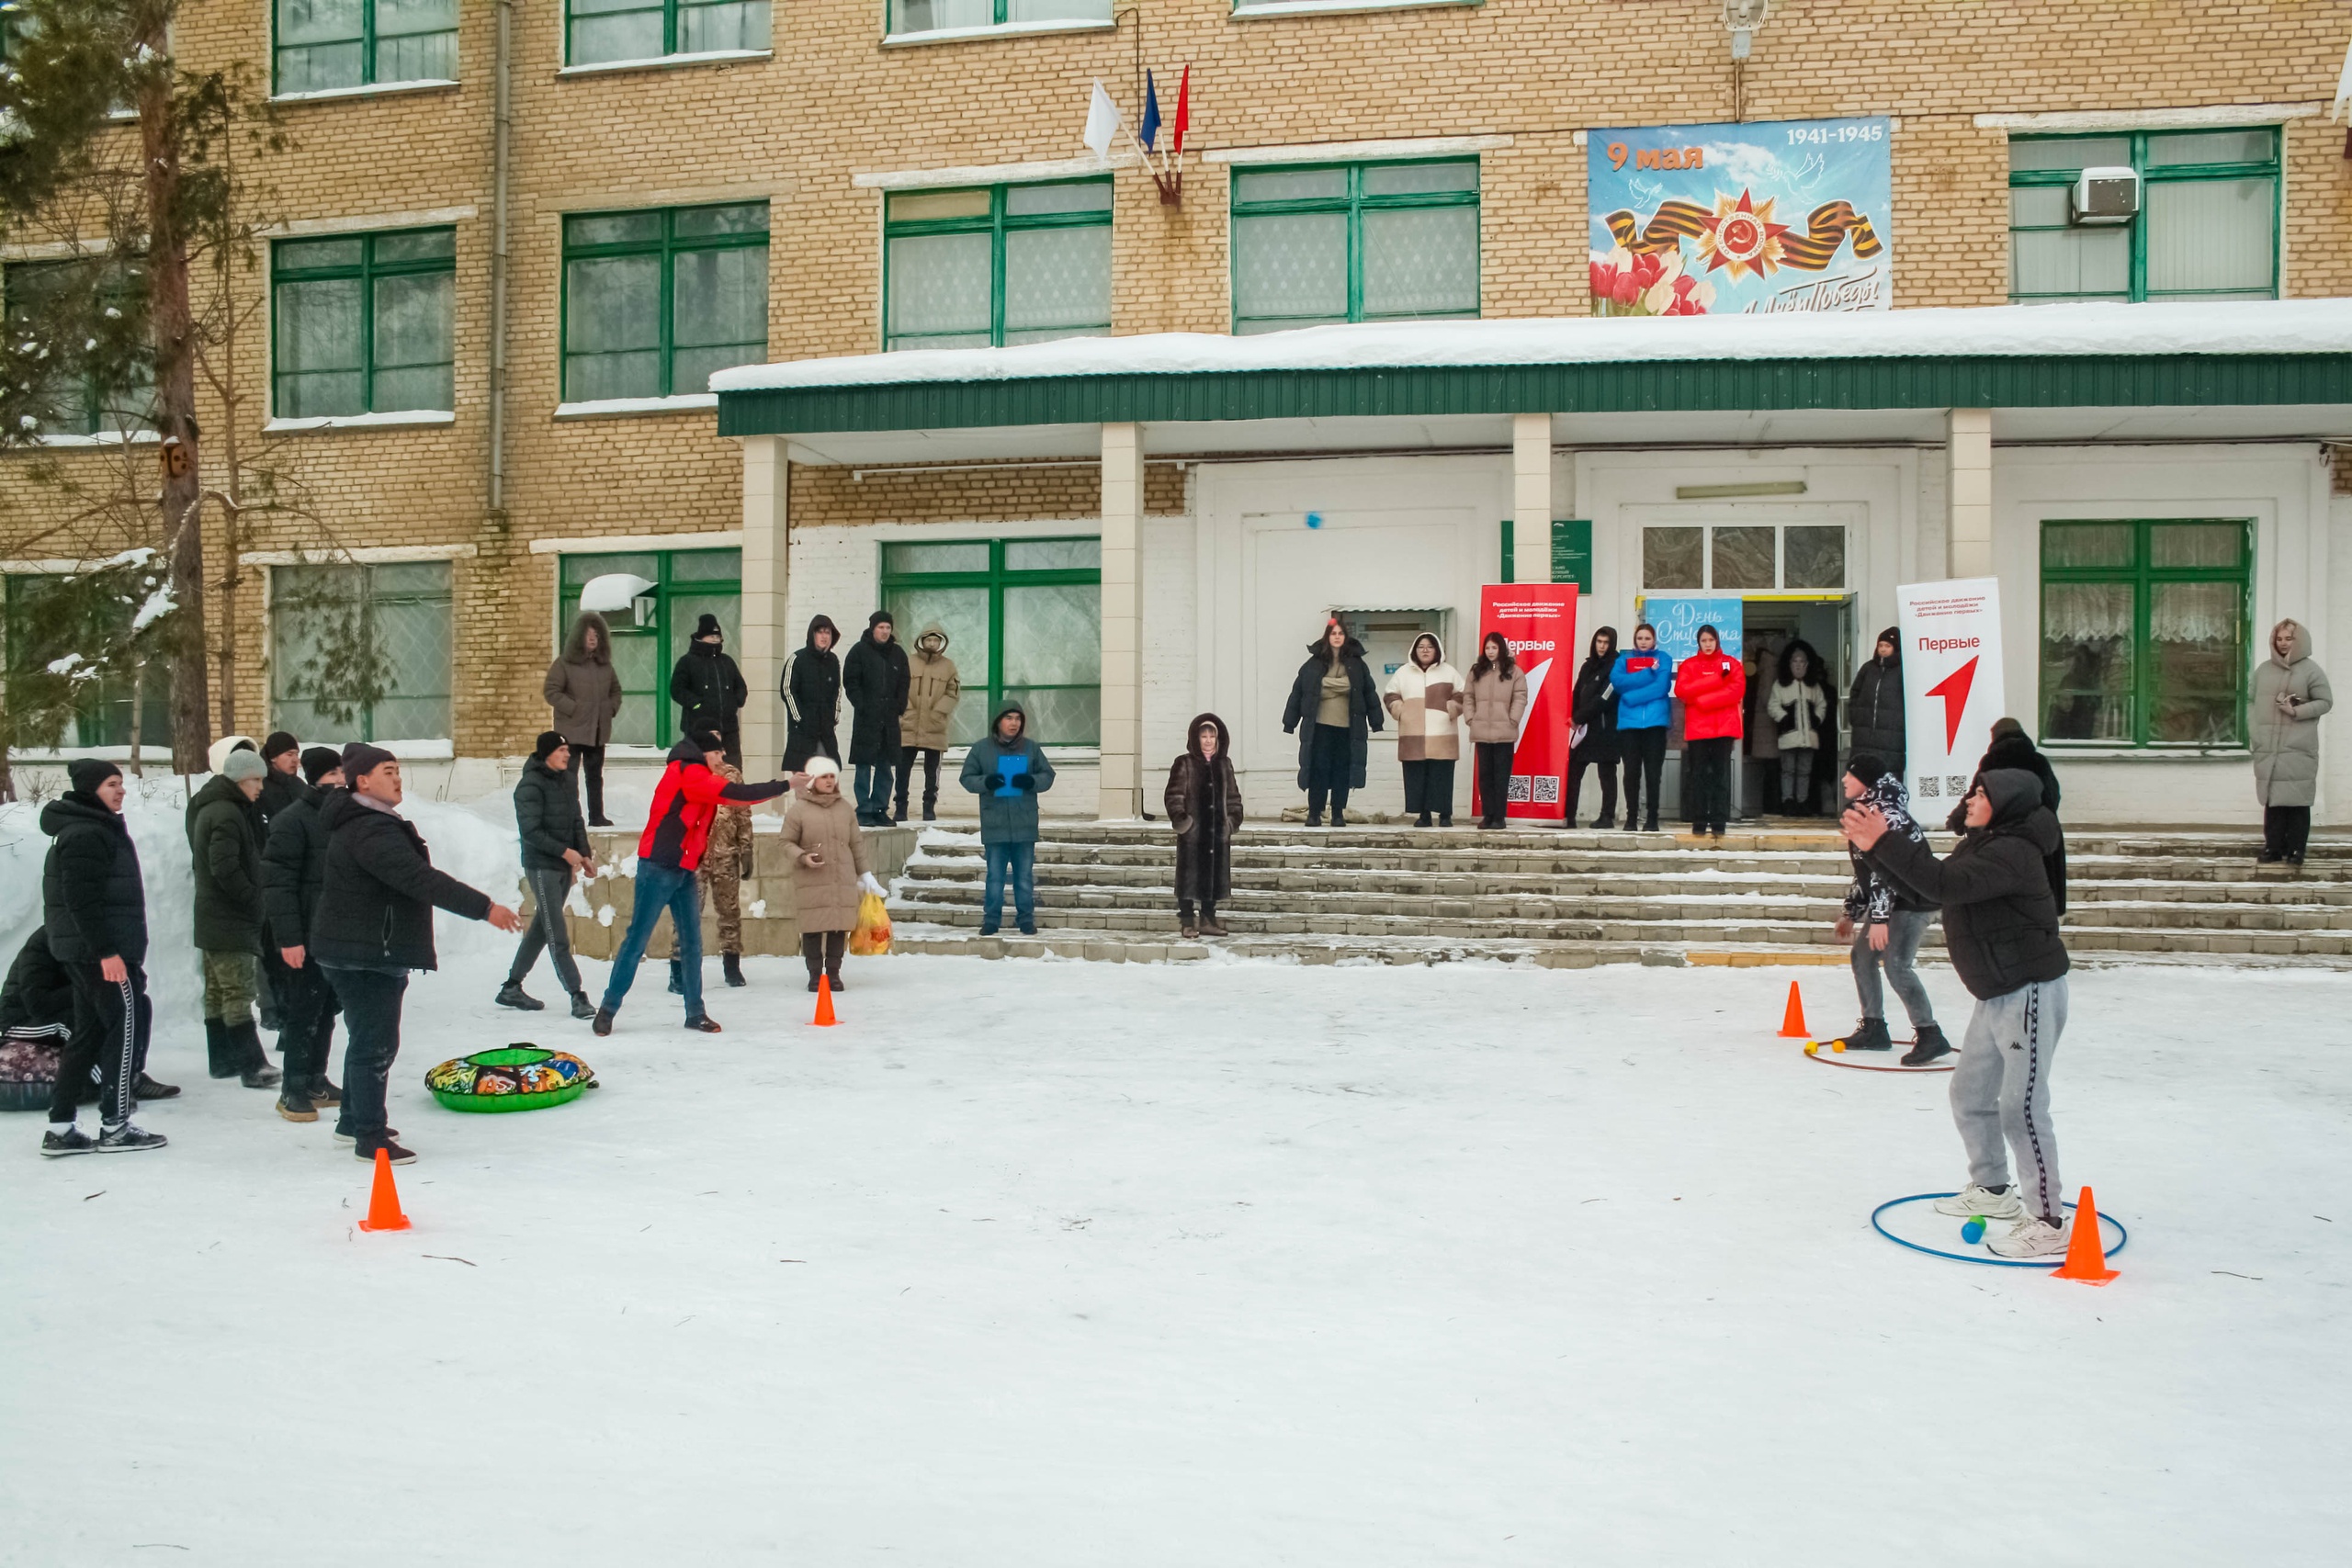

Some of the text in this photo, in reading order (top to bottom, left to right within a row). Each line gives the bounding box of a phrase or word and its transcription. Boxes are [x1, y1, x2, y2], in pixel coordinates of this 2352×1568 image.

[1787, 125, 1883, 145] 1941-1945
[1608, 142, 1704, 172] 9 мая
[1672, 602, 1724, 626] День
[1918, 637, 1981, 654] Первые
